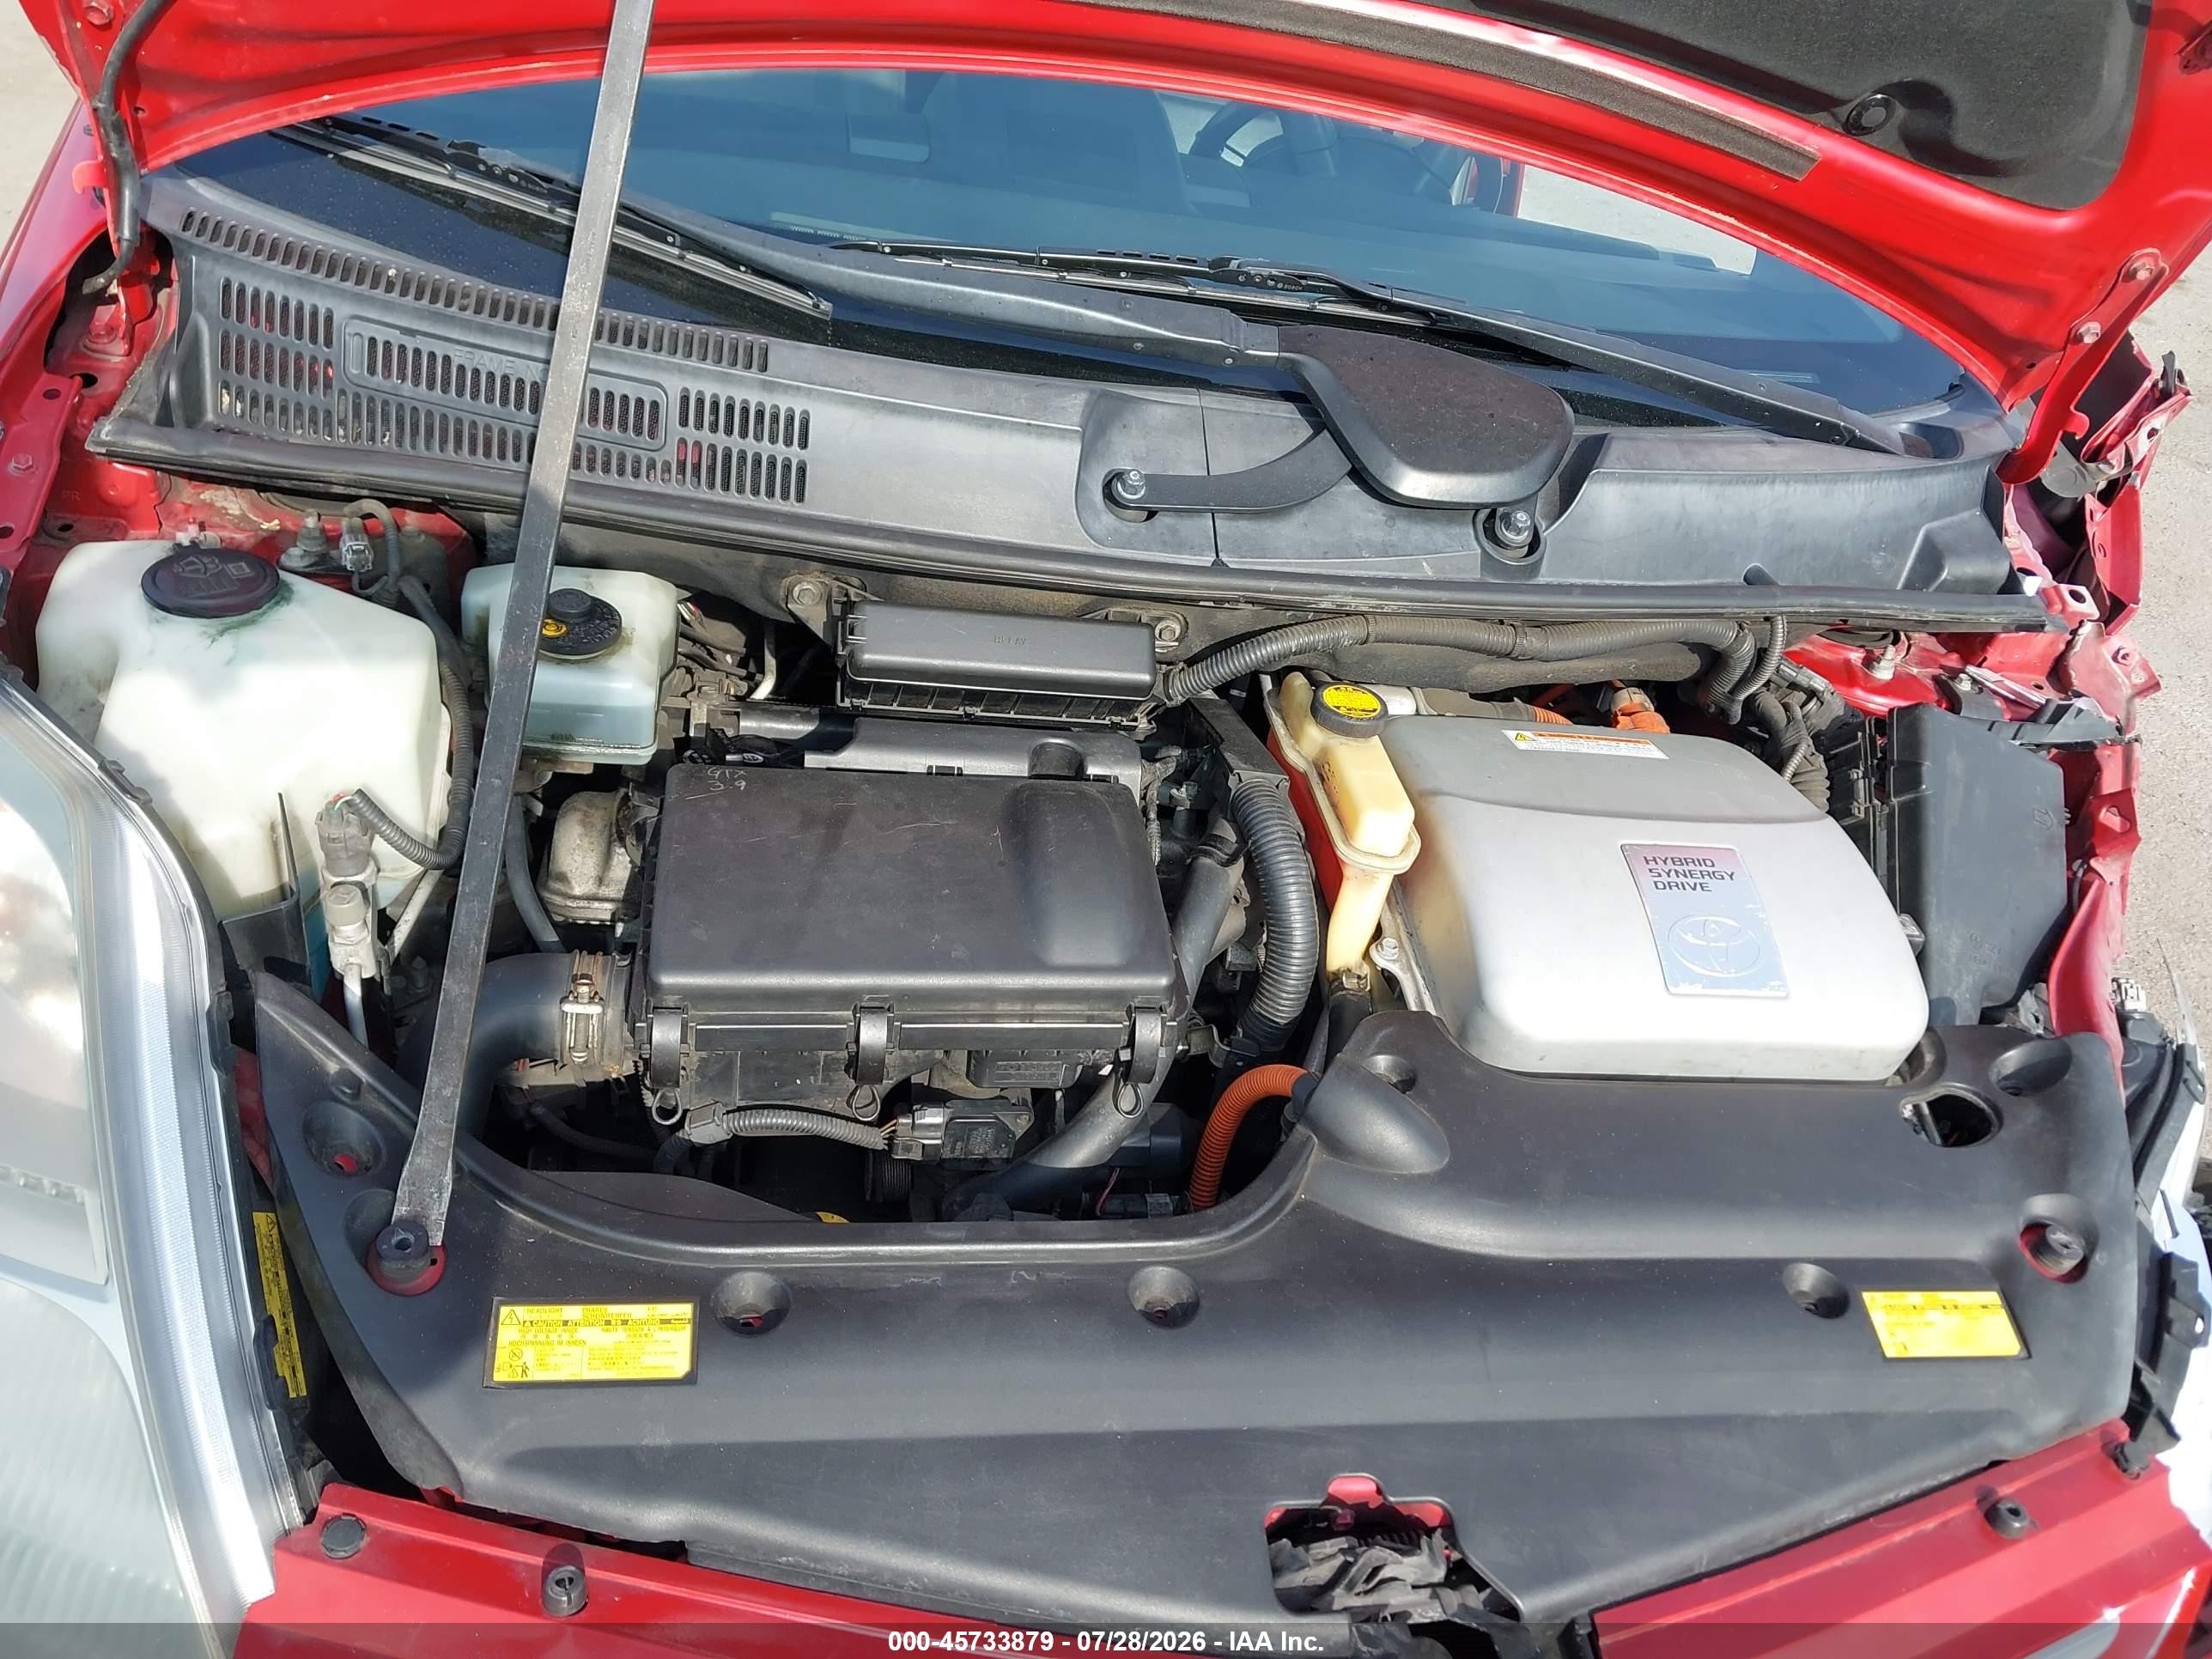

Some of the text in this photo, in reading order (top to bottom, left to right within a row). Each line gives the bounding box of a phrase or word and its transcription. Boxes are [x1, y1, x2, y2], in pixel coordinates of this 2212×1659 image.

[453, 348, 516, 376] FRAME
[1643, 855, 1716, 868] HYBRID
[1648, 867, 1735, 881] SYNERGY
[1652, 880, 1712, 892] DRIVE
